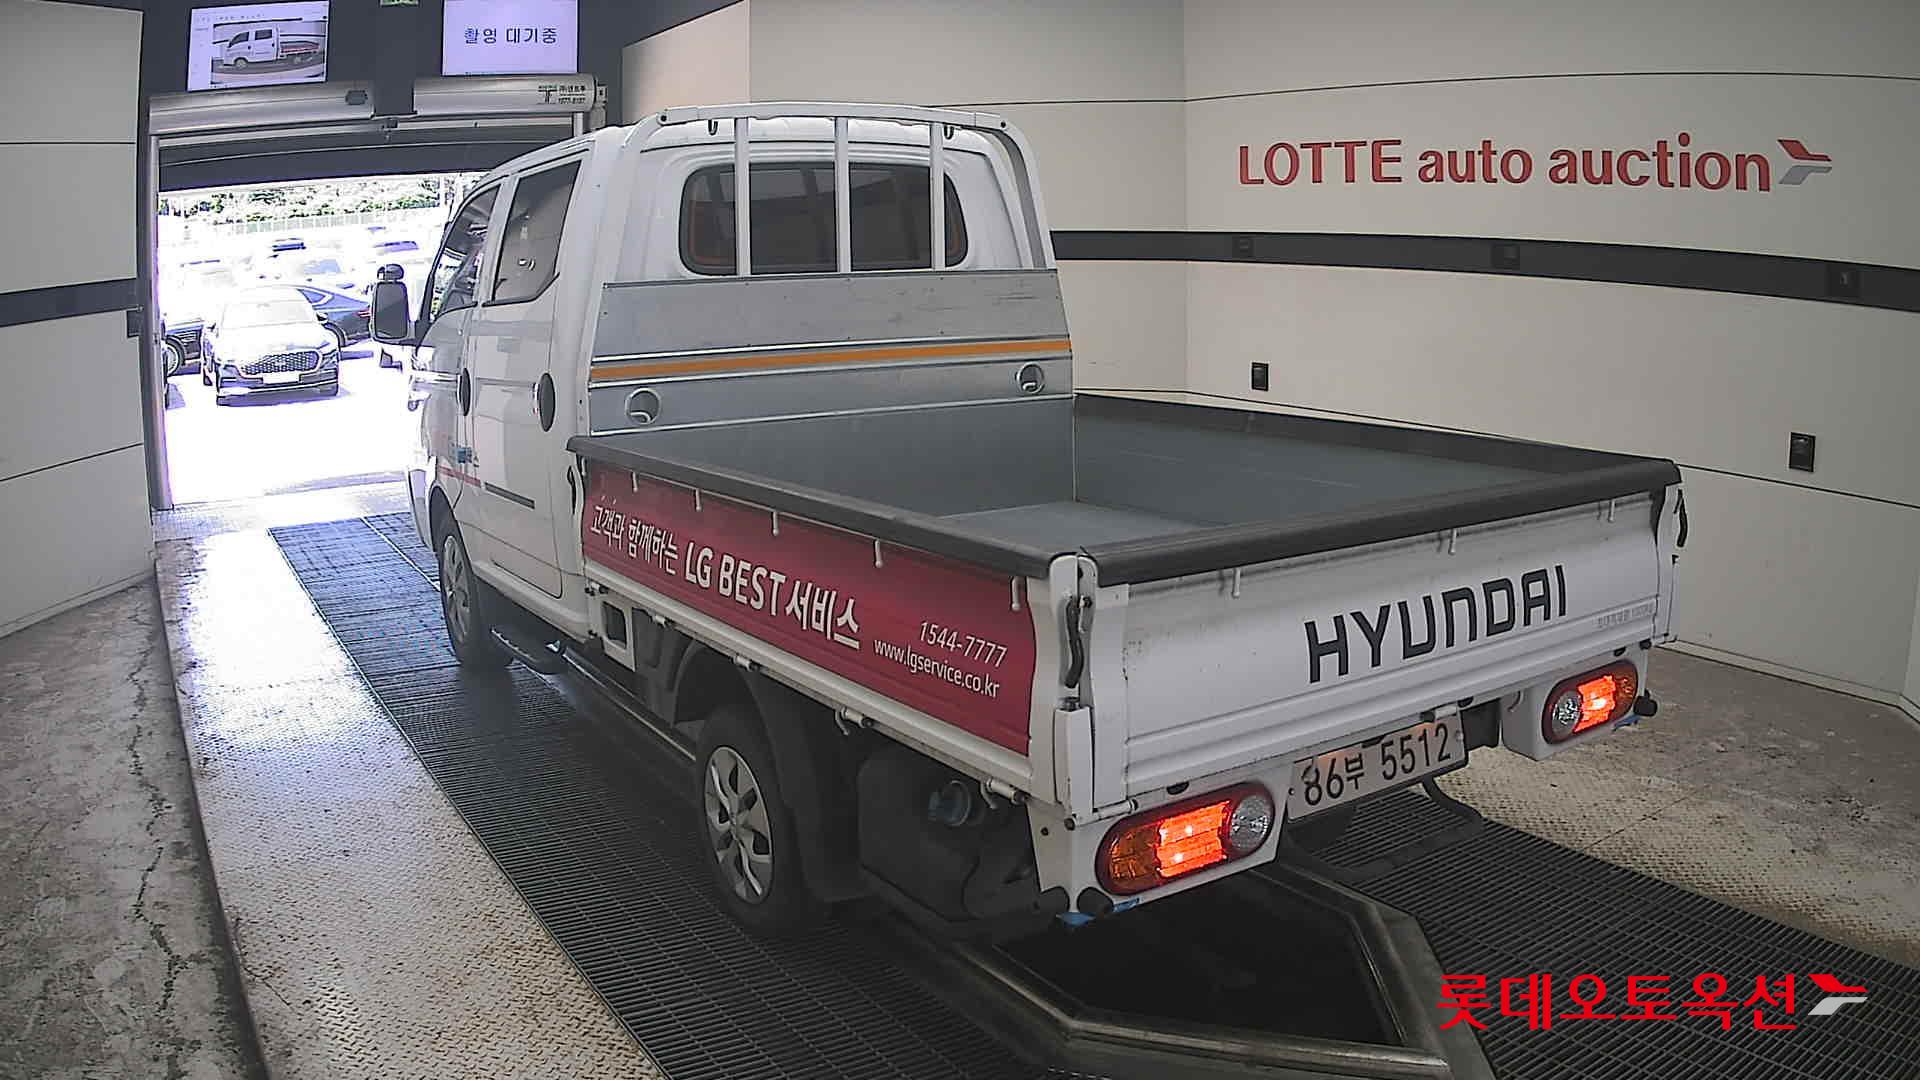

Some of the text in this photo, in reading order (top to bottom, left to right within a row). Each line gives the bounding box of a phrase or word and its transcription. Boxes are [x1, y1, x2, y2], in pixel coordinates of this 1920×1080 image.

[465, 27, 557, 44] 촬영 대기중
[1239, 132, 1770, 191] LOTTE auto auction
[590, 505, 860, 649] 고객과 함께하는 LG BEST 서비스
[919, 621, 1008, 668] 1544-7777
[1304, 564, 1567, 683] HYUNDAI
[873, 639, 1000, 698] www.lgservice.co.kr
[1301, 723, 1451, 806] 86부 5512
